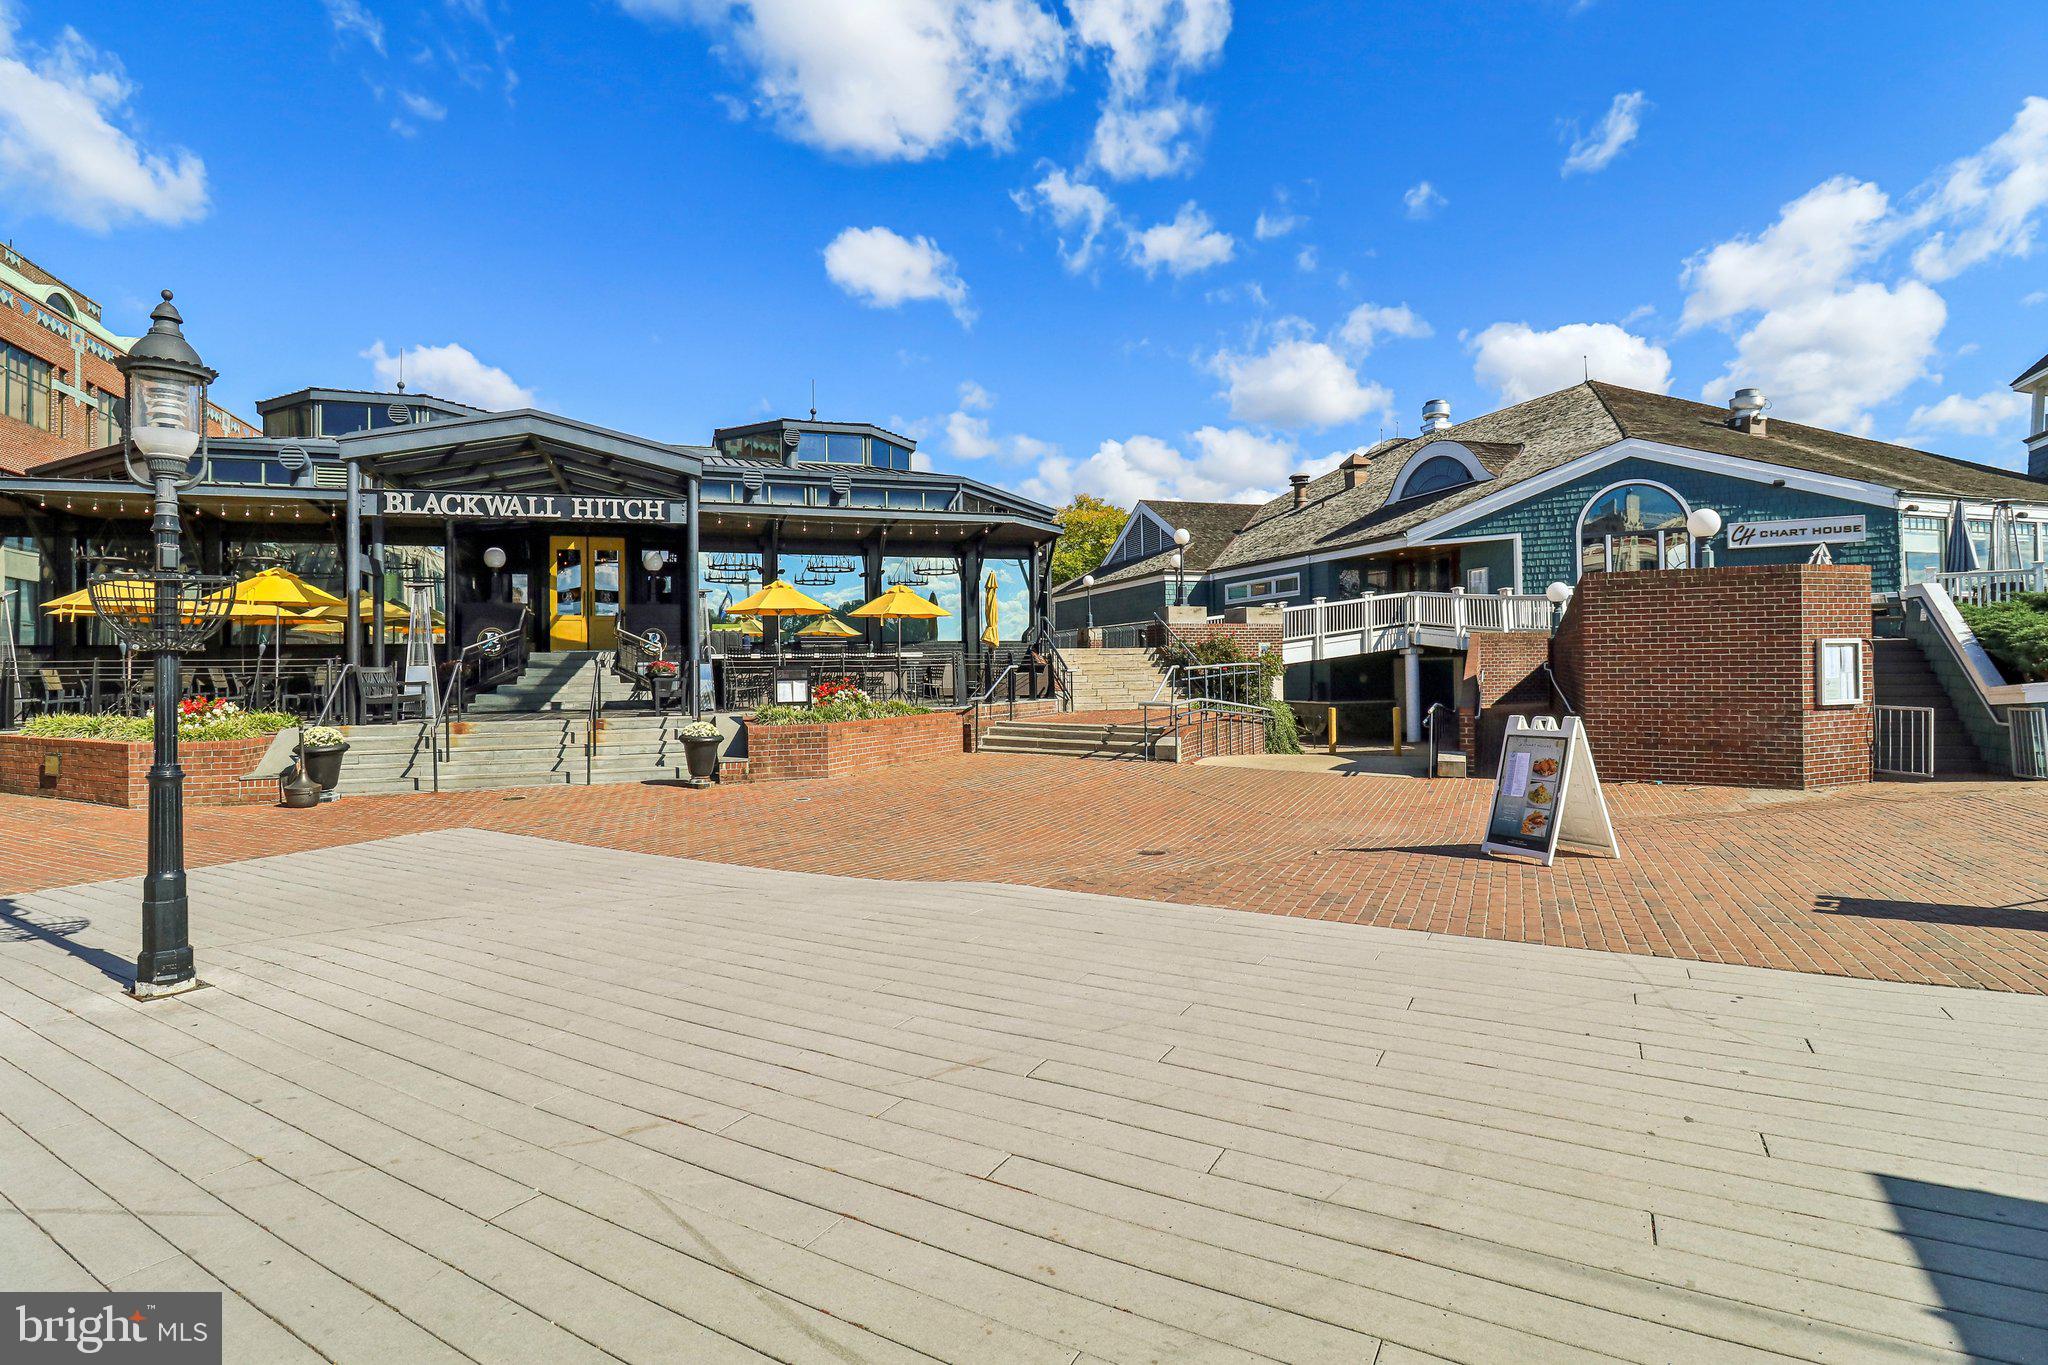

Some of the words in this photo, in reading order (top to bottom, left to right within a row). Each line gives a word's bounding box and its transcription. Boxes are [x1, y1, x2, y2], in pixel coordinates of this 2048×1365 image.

[383, 491, 562, 518] BLACKWALL
[571, 497, 665, 521] HITCH
[1760, 527, 1808, 538] CHART
[1812, 524, 1862, 535] HOUSE
